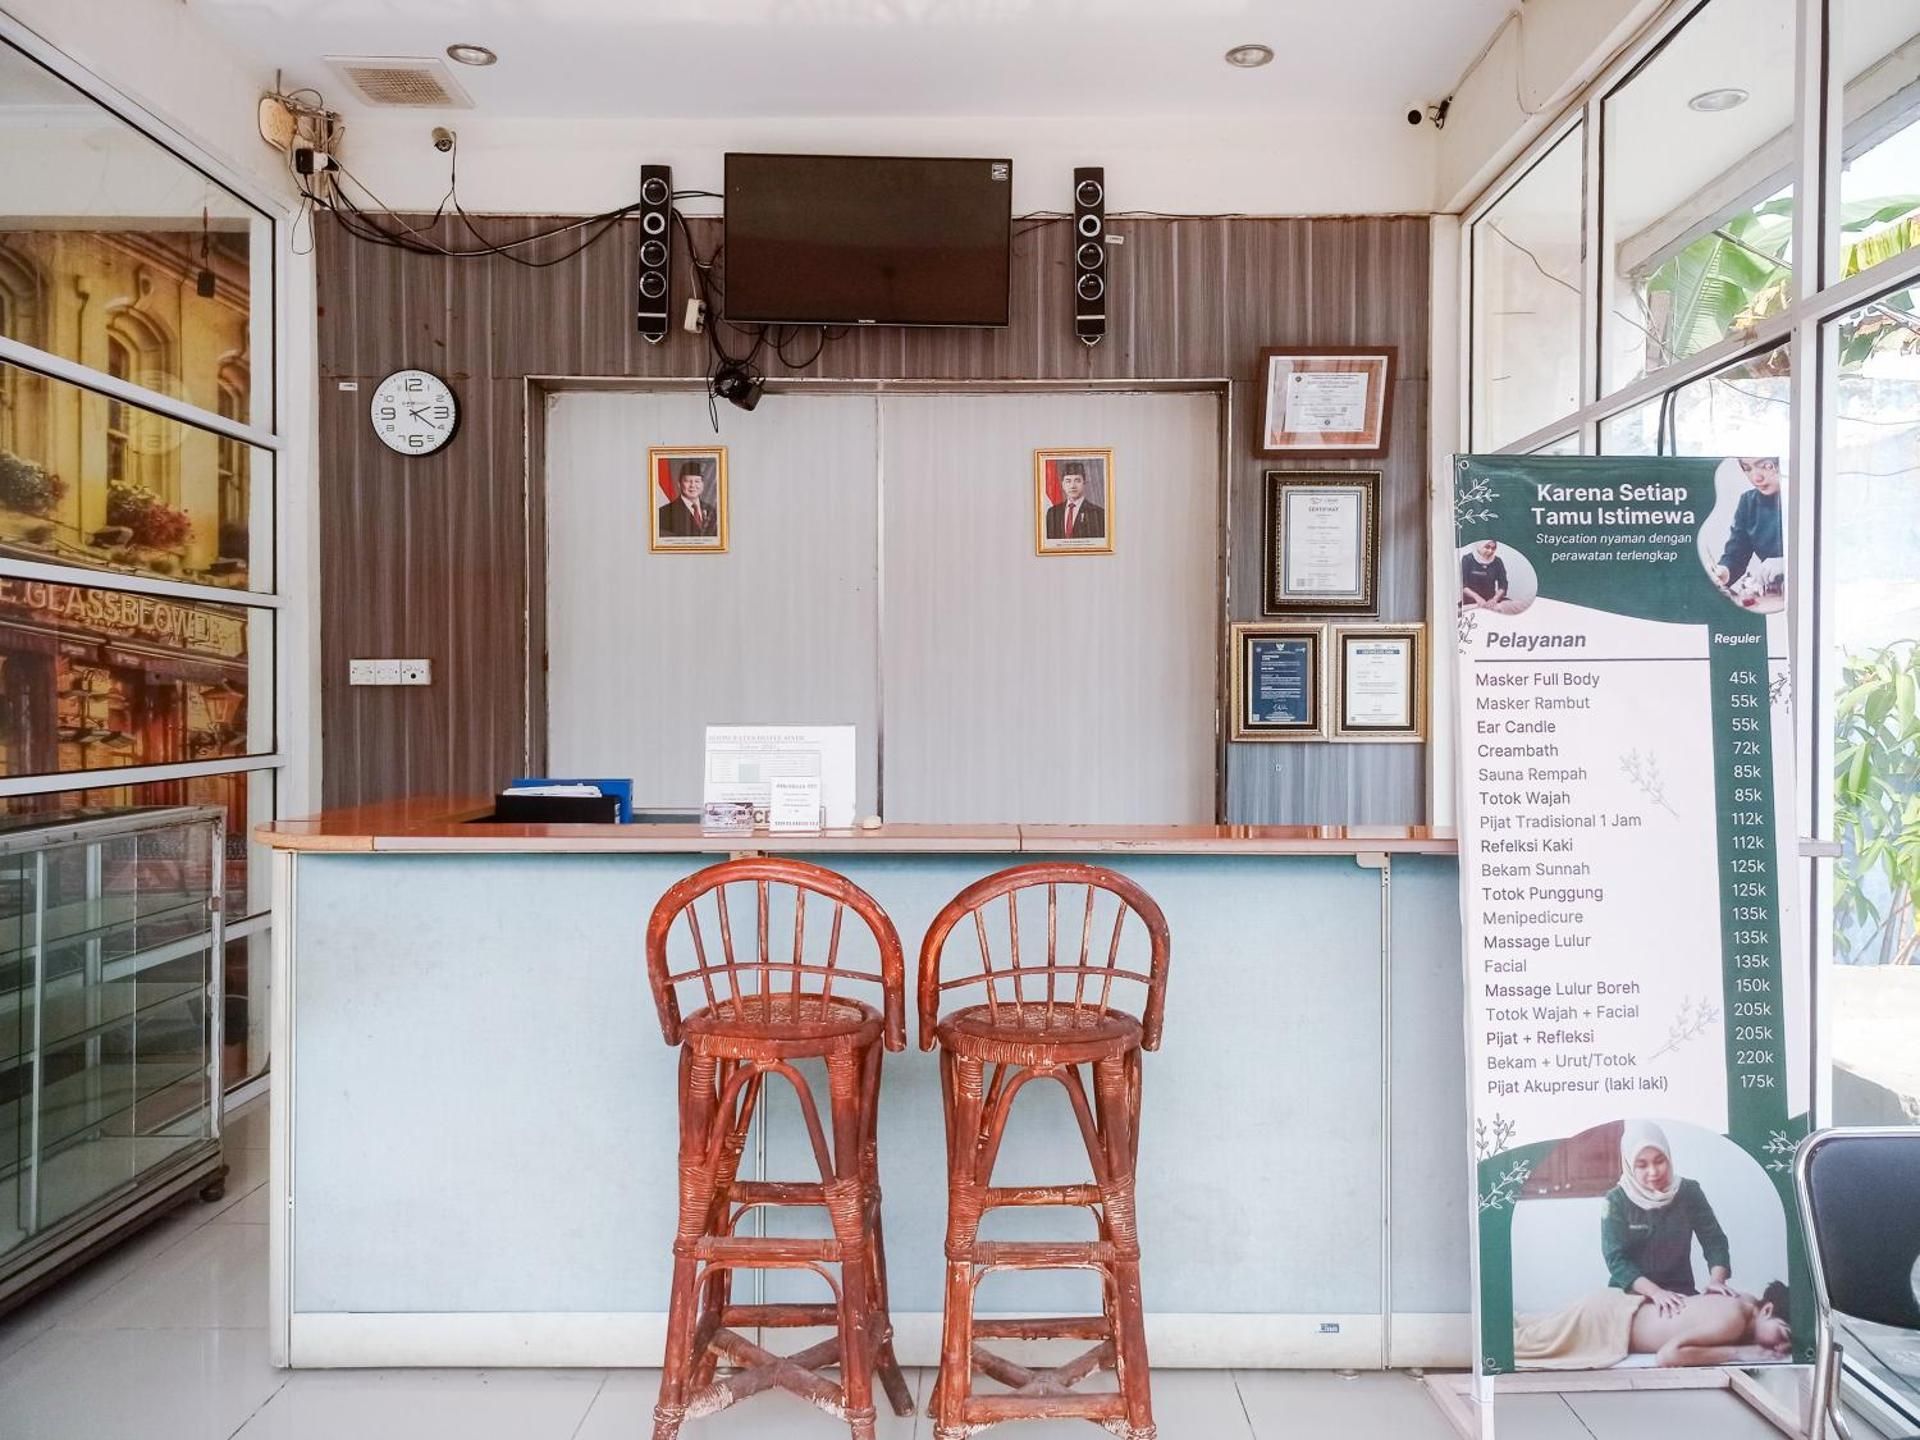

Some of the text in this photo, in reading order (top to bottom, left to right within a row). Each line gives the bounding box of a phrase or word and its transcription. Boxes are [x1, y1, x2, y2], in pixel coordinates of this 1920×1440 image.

[405, 378, 423, 392] 12
[381, 407, 396, 420] 9
[434, 406, 449, 419] 3
[409, 434, 424, 447] 6
[1537, 483, 1687, 505] Karena Setiap
[1531, 507, 1694, 525] Tamu Istimewa
[1536, 533, 1691, 546] Staycation nyaman dengan
[1551, 550, 1677, 562] perawatan terlengkap
[1487, 632, 1585, 651] Pelayanan
[1715, 634, 1761, 645] Reguler
[1476, 672, 1599, 688] Masker Full Body
[1730, 672, 1756, 684] 45k
[1477, 697, 1590, 710] Masker Rambut
[1732, 695, 1758, 707] 55k
[1478, 721, 1555, 733] Ear Candle
[1733, 718, 1759, 731] 55k
[1478, 744, 1558, 757] Creambath
[1733, 741, 1760, 754] 72k
[1479, 768, 1586, 783] Sauna Rempah
[1734, 765, 1761, 777] 85k
[1480, 791, 1570, 807] Totok Wajah
[1735, 788, 1762, 801] 85k
[1481, 814, 1641, 831] Pijat Tradisional 1 Jam
[1732, 812, 1763, 825] 112k
[1543, 838, 1572, 851] Kaki
[1733, 836, 1764, 849] 112k
[1482, 862, 1590, 876] Bekam Sunnah
[1731, 860, 1765, 872] 125k
[1482, 887, 1603, 902] Totok Punggung
[1732, 883, 1766, 896] 125k
[1483, 911, 1583, 927] Menipedicure
[1733, 907, 1767, 920] 135k
[1485, 934, 1591, 951] Massage Lulur
[1734, 931, 1768, 944] 135k
[1485, 959, 1526, 972] Facial
[1735, 955, 1769, 968] 135k
[1486, 981, 1640, 999] Massage Lulur Boreh
[1736, 979, 1770, 992] 150k
[1486, 1008, 1528, 1021] Totok
[1533, 1006, 1577, 1022] Wajah
[1597, 1005, 1638, 1018] Facial
[1735, 1002, 1771, 1015] 205k
[1487, 1030, 1593, 1048] Pijat + Refleksi
[1736, 1026, 1772, 1040] 205k
[1488, 1053, 1636, 1069] Bekam + Urut/Totok
[1737, 1051, 1774, 1064] 220k
[1488, 1076, 1667, 1096] Pijat Akupresur (laki laki)
[1741, 1075, 1774, 1088] 175k
